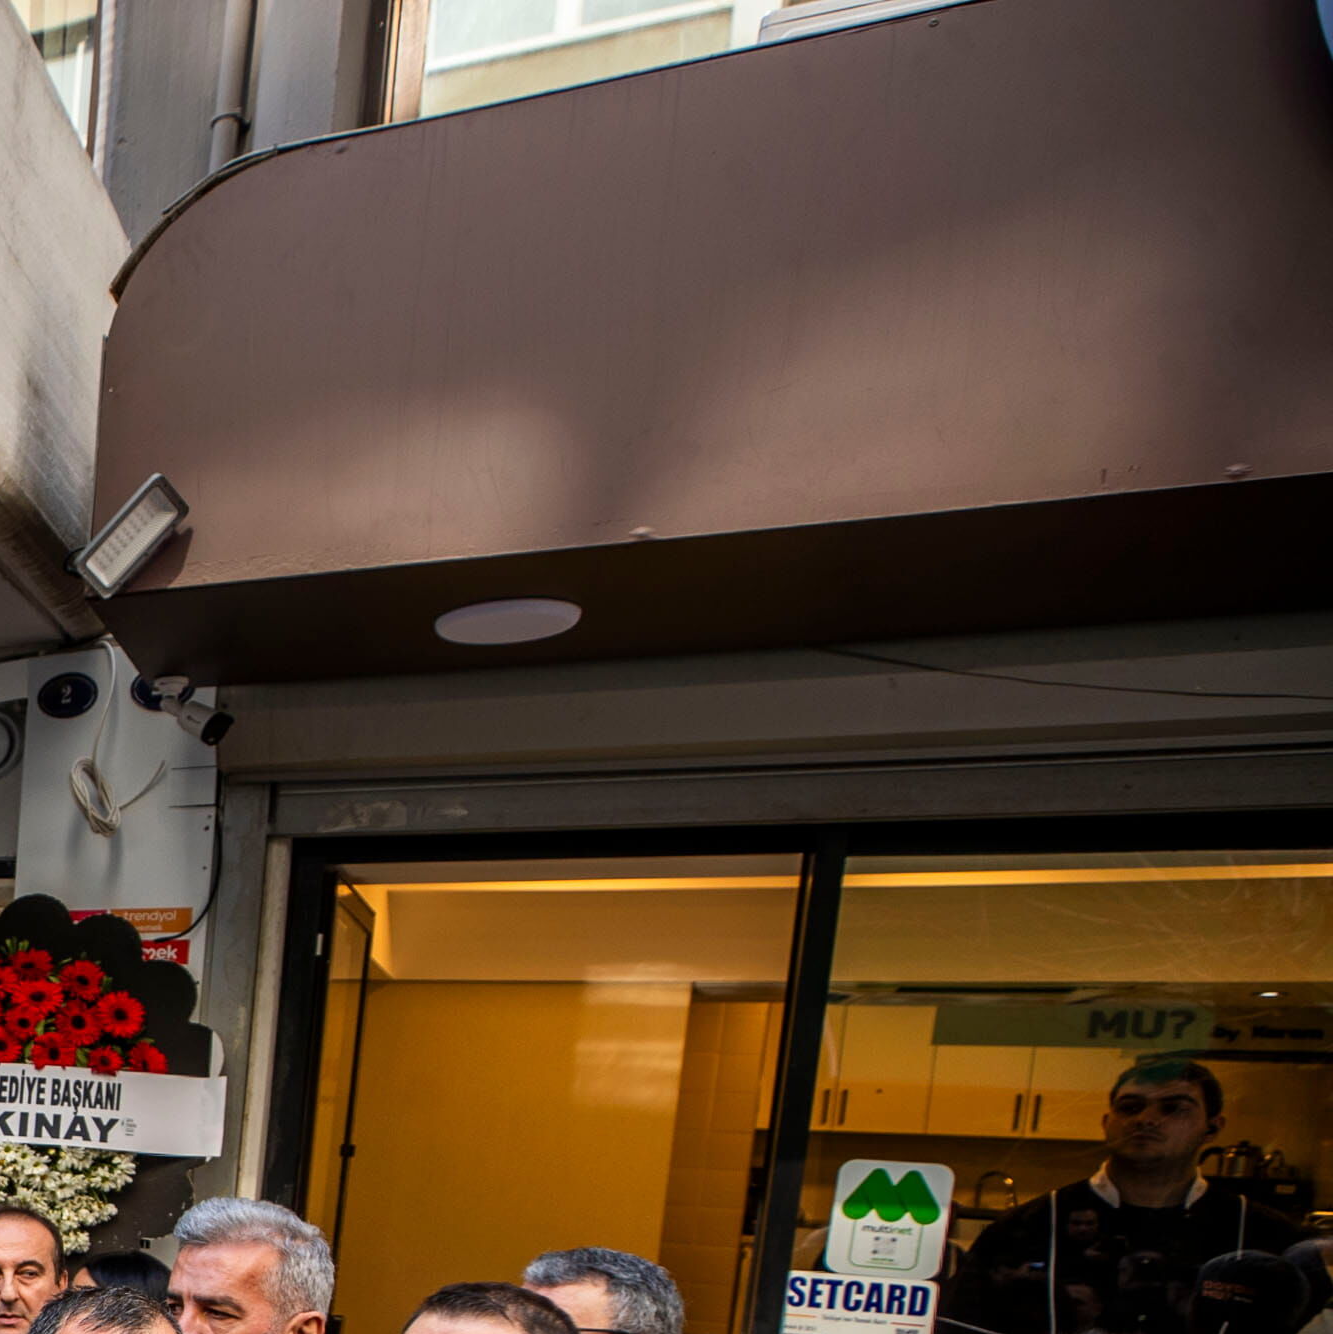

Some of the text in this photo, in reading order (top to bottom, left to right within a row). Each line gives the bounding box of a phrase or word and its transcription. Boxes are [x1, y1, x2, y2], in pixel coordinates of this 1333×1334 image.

[60, 684, 73, 705] 2
[124, 910, 177, 922] trendyol
[1086, 1009, 1196, 1040] MU?
[51, 1077, 122, 1113] BAŞKANI
[787, 1276, 931, 1317] SETCARD
